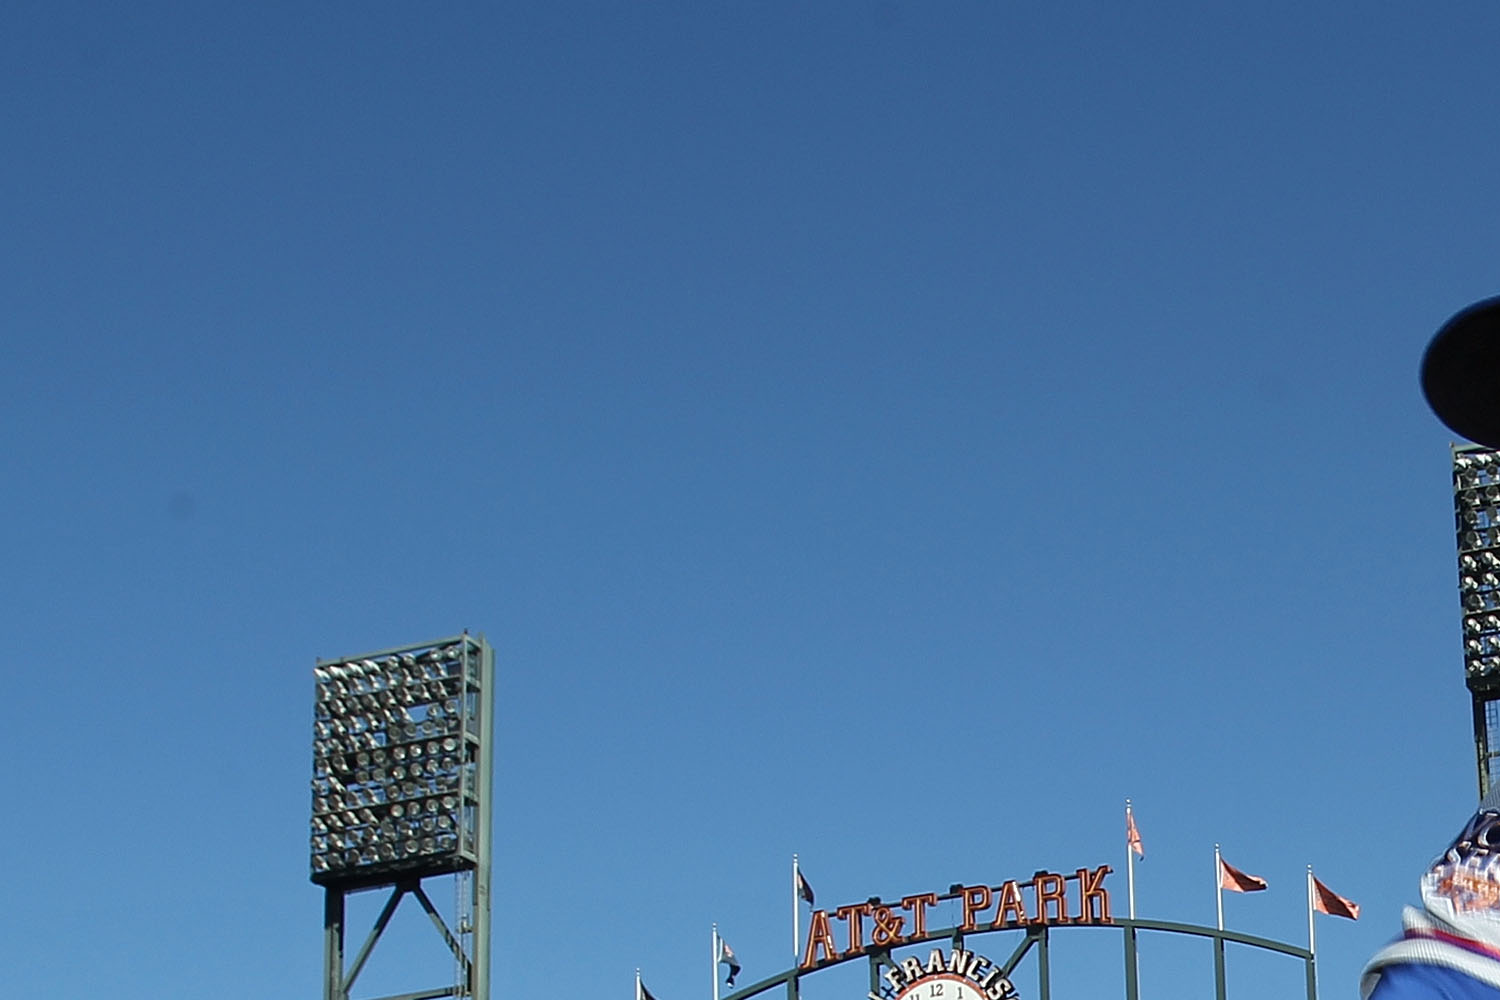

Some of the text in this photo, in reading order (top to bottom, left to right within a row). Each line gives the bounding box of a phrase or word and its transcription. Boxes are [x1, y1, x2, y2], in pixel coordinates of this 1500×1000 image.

[802, 864, 1116, 969] AT&T PARK
[930, 984, 944, 998] 12
[957, 986, 964, 1000] 1
